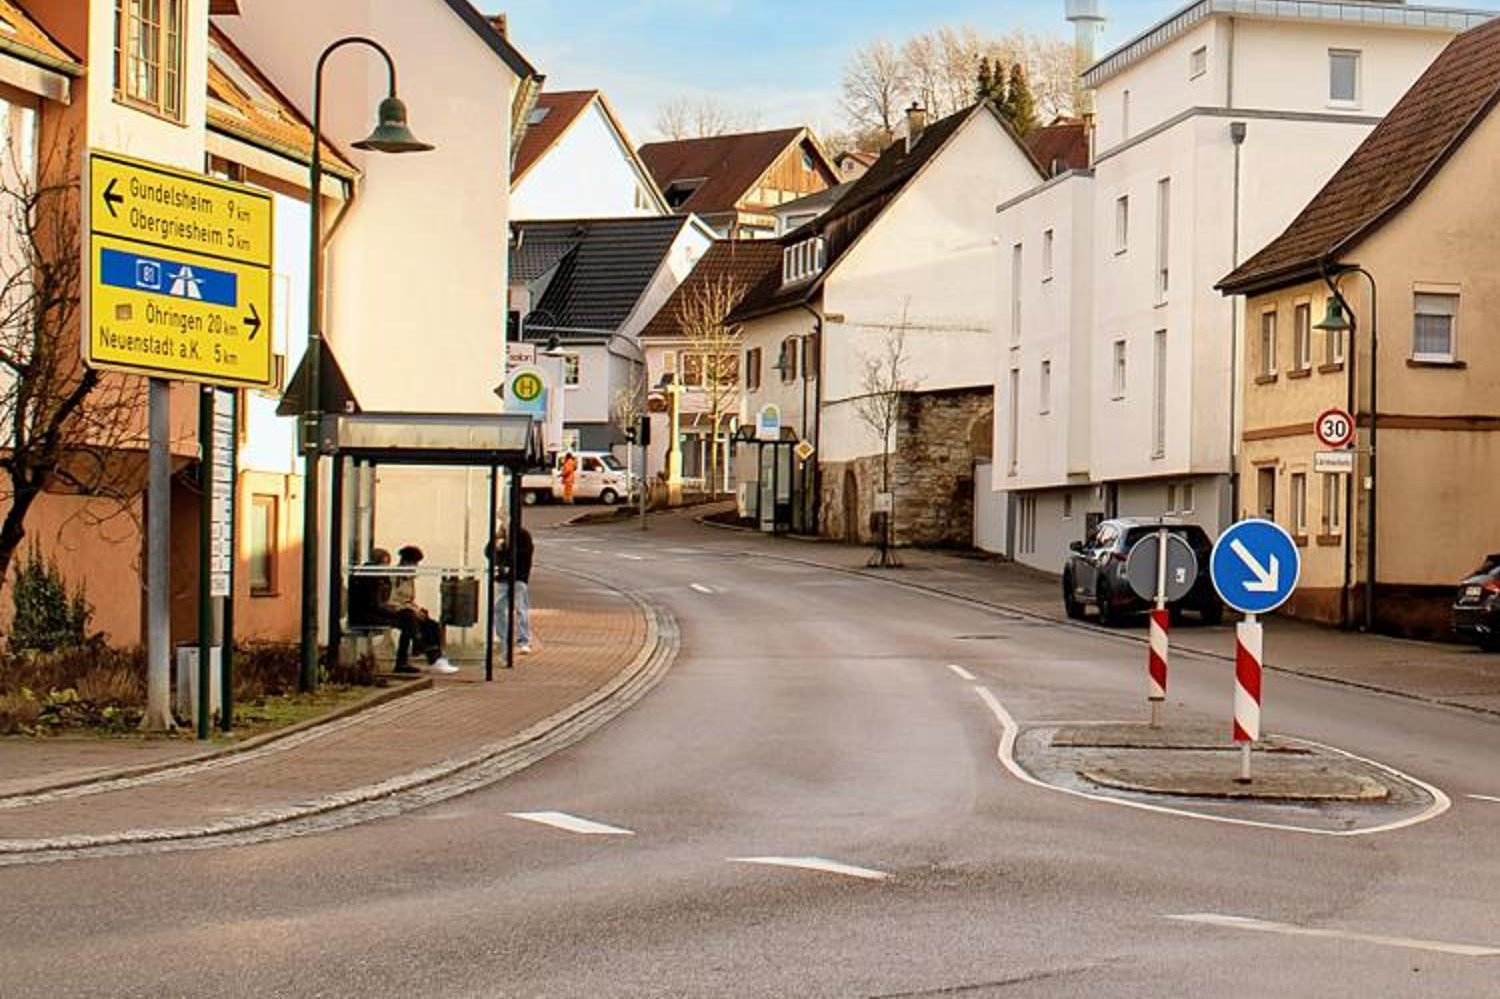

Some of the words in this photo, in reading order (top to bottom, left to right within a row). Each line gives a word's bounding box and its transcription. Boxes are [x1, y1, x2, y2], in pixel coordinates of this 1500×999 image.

[130, 176, 213, 214] Gundelsheim
[227, 200, 235, 219] 9
[237, 207, 251, 222] km
[130, 207, 223, 246] Obergriesheim
[227, 229, 235, 247] 5
[237, 235, 250, 251] km
[143, 266, 155, 282] 81
[145, 298, 203, 333] Öhringen
[208, 313, 223, 334] 20
[224, 321, 237, 336] km
[100, 326, 175, 356] Neuenstadt
[179, 339, 202, 362] a.K.
[214, 344, 222, 363] 5
[224, 349, 237, 365] km
[520, 377, 533, 395] H
[1323, 419, 1346, 438] 30
